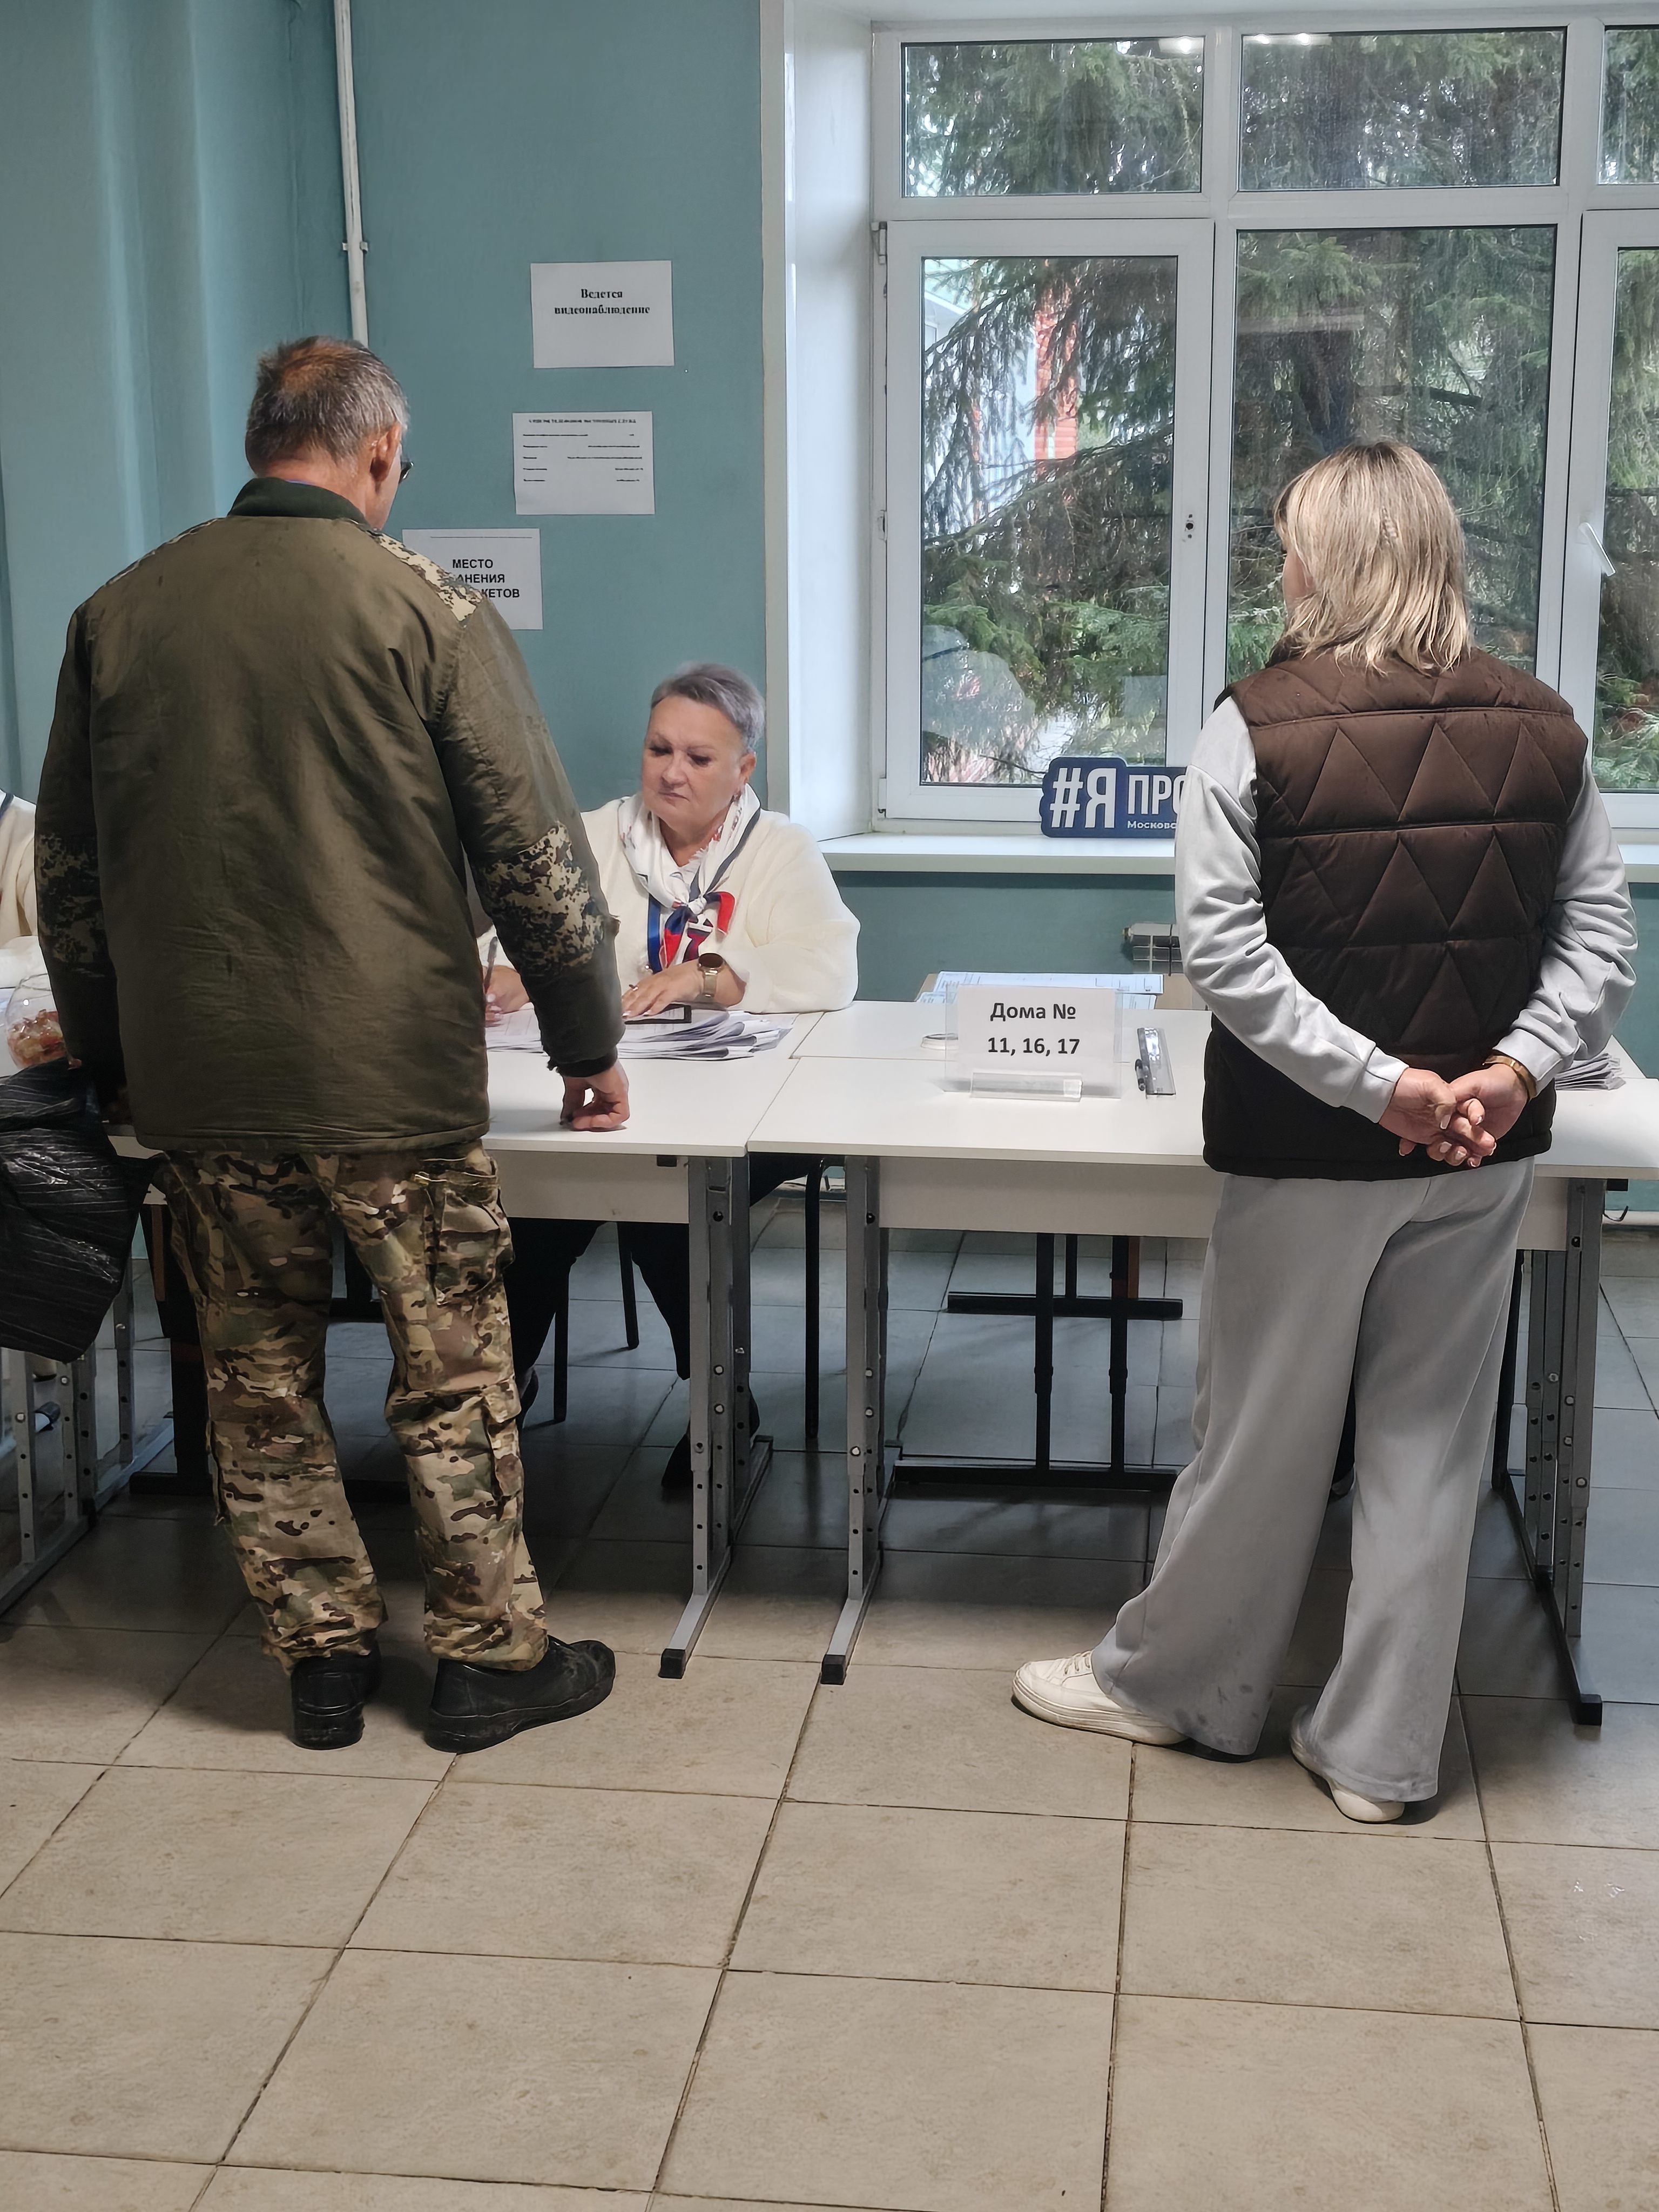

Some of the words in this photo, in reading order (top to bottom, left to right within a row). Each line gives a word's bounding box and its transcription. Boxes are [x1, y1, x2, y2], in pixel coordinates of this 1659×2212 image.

[581, 289, 623, 299] Ведется
[555, 305, 650, 315] видеонаблюдение
[453, 559, 494, 569] МЕСТО
[457, 574, 505, 583] АНЕНИЯ
[1050, 767, 1117, 828] #Я
[1127, 820, 1177, 829] Московс
[990, 1002, 1046, 1022] Дома
[1053, 1003, 1076, 1020] №
[988, 1037, 1016, 1056] 11,
[1023, 1038, 1050, 1057] 16,
[1058, 1038, 1080, 1054] 17
